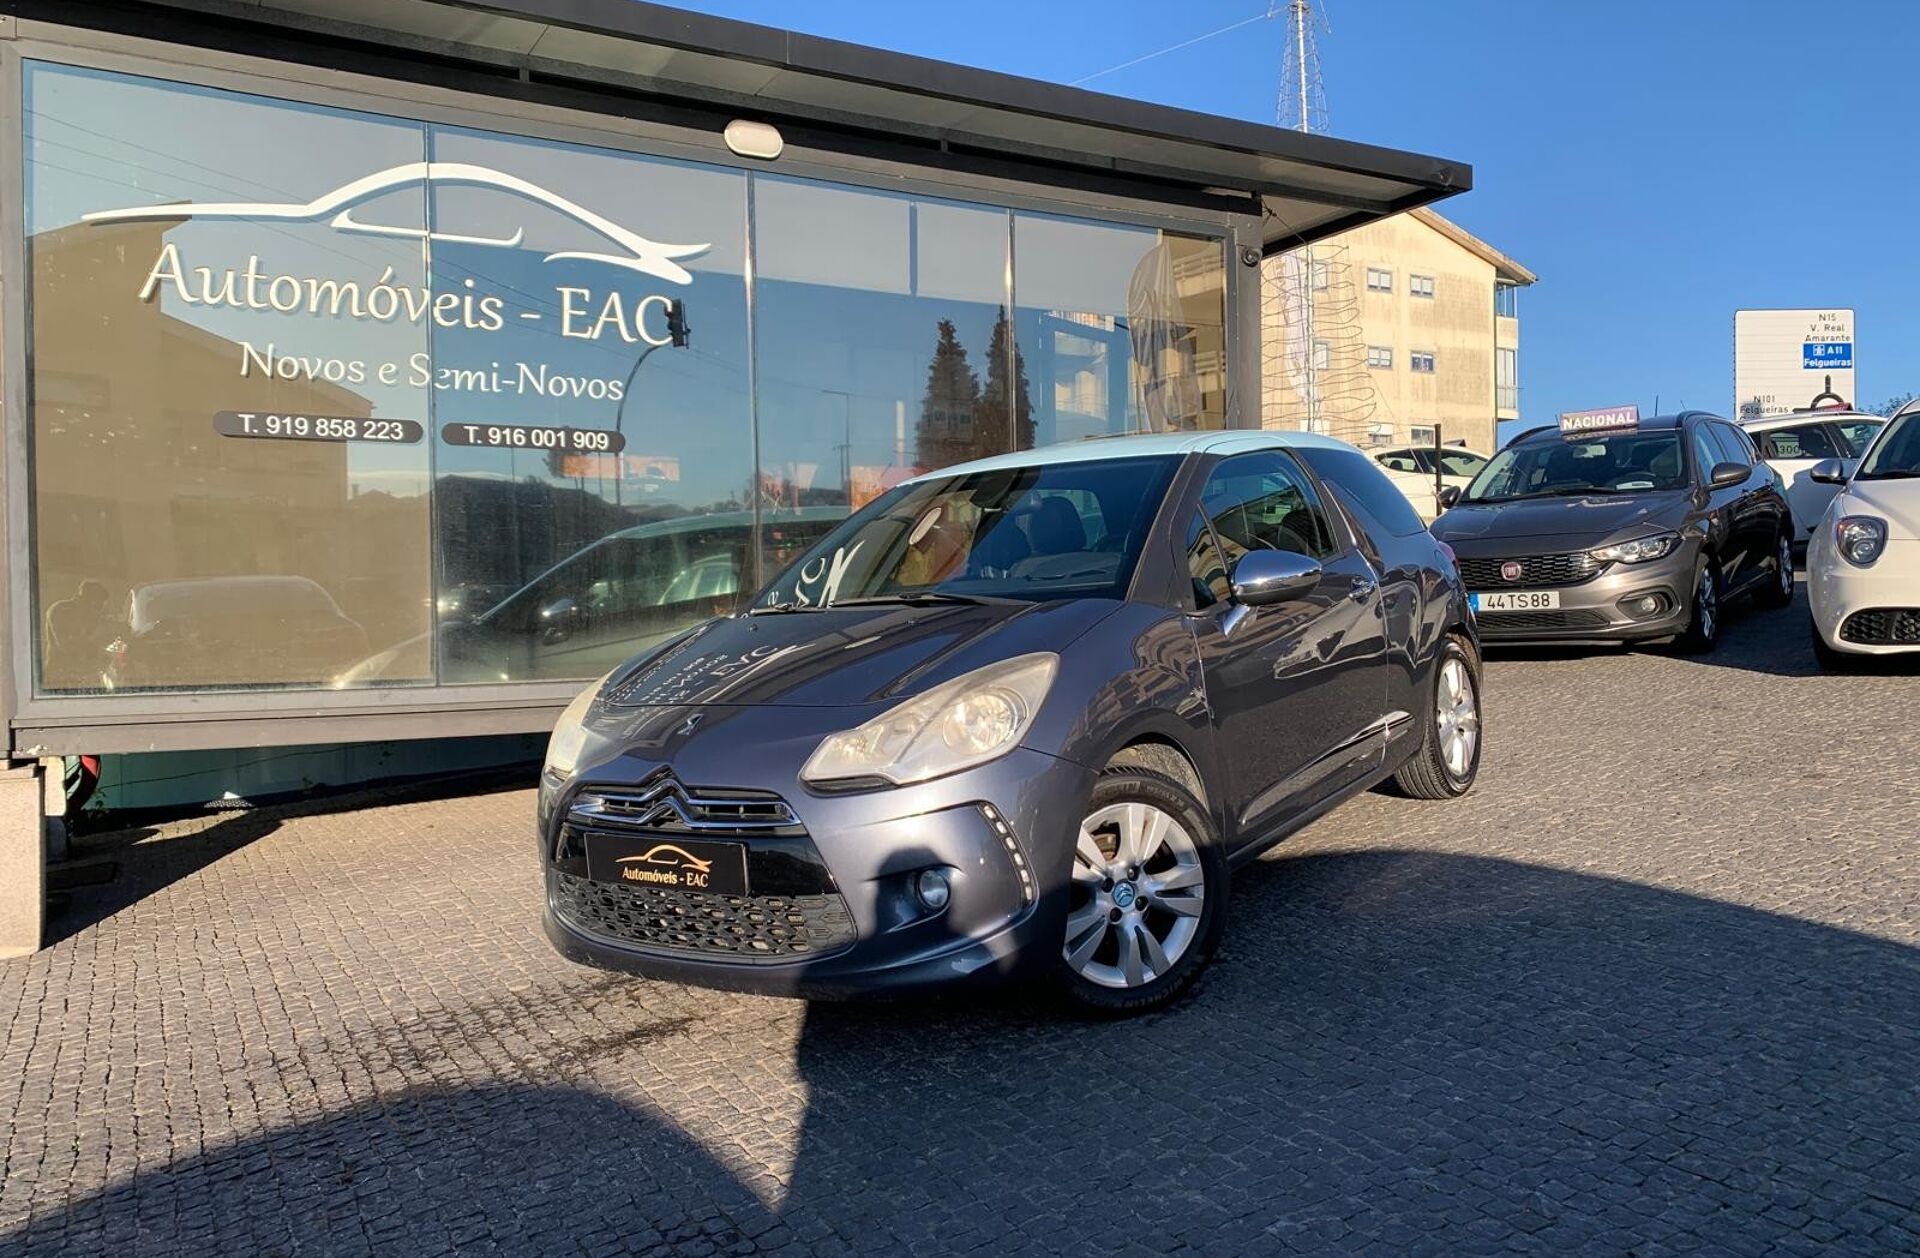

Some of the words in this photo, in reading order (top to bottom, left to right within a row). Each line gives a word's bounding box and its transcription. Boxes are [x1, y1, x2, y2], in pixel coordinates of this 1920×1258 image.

[138, 243, 504, 331] Automóveis
[556, 287, 674, 346] EAC
[1818, 313, 1837, 322] N15
[1810, 324, 1820, 332] V.
[1824, 323, 1845, 332] Real
[1805, 334, 1851, 342] Amarante
[1804, 358, 1852, 368] Felgueiras
[238, 341, 365, 382] Novos
[378, 362, 398, 385] e
[408, 353, 624, 400] Semi-Novos
[1753, 394, 1775, 403] N101
[1740, 405, 1789, 415] Felgueiras
[238, 414, 258, 433] T.
[266, 415, 309, 436] 919
[315, 418, 357, 438] 858
[363, 420, 403, 440] 223
[1563, 411, 1635, 430] NACIONAL
[464, 425, 482, 444] T.
[487, 427, 526, 446] 916
[531, 429, 566, 448] 001
[573, 431, 609, 450] 909
[622, 866, 678, 885] Automóveis
[686, 872, 709, 888] EAC
